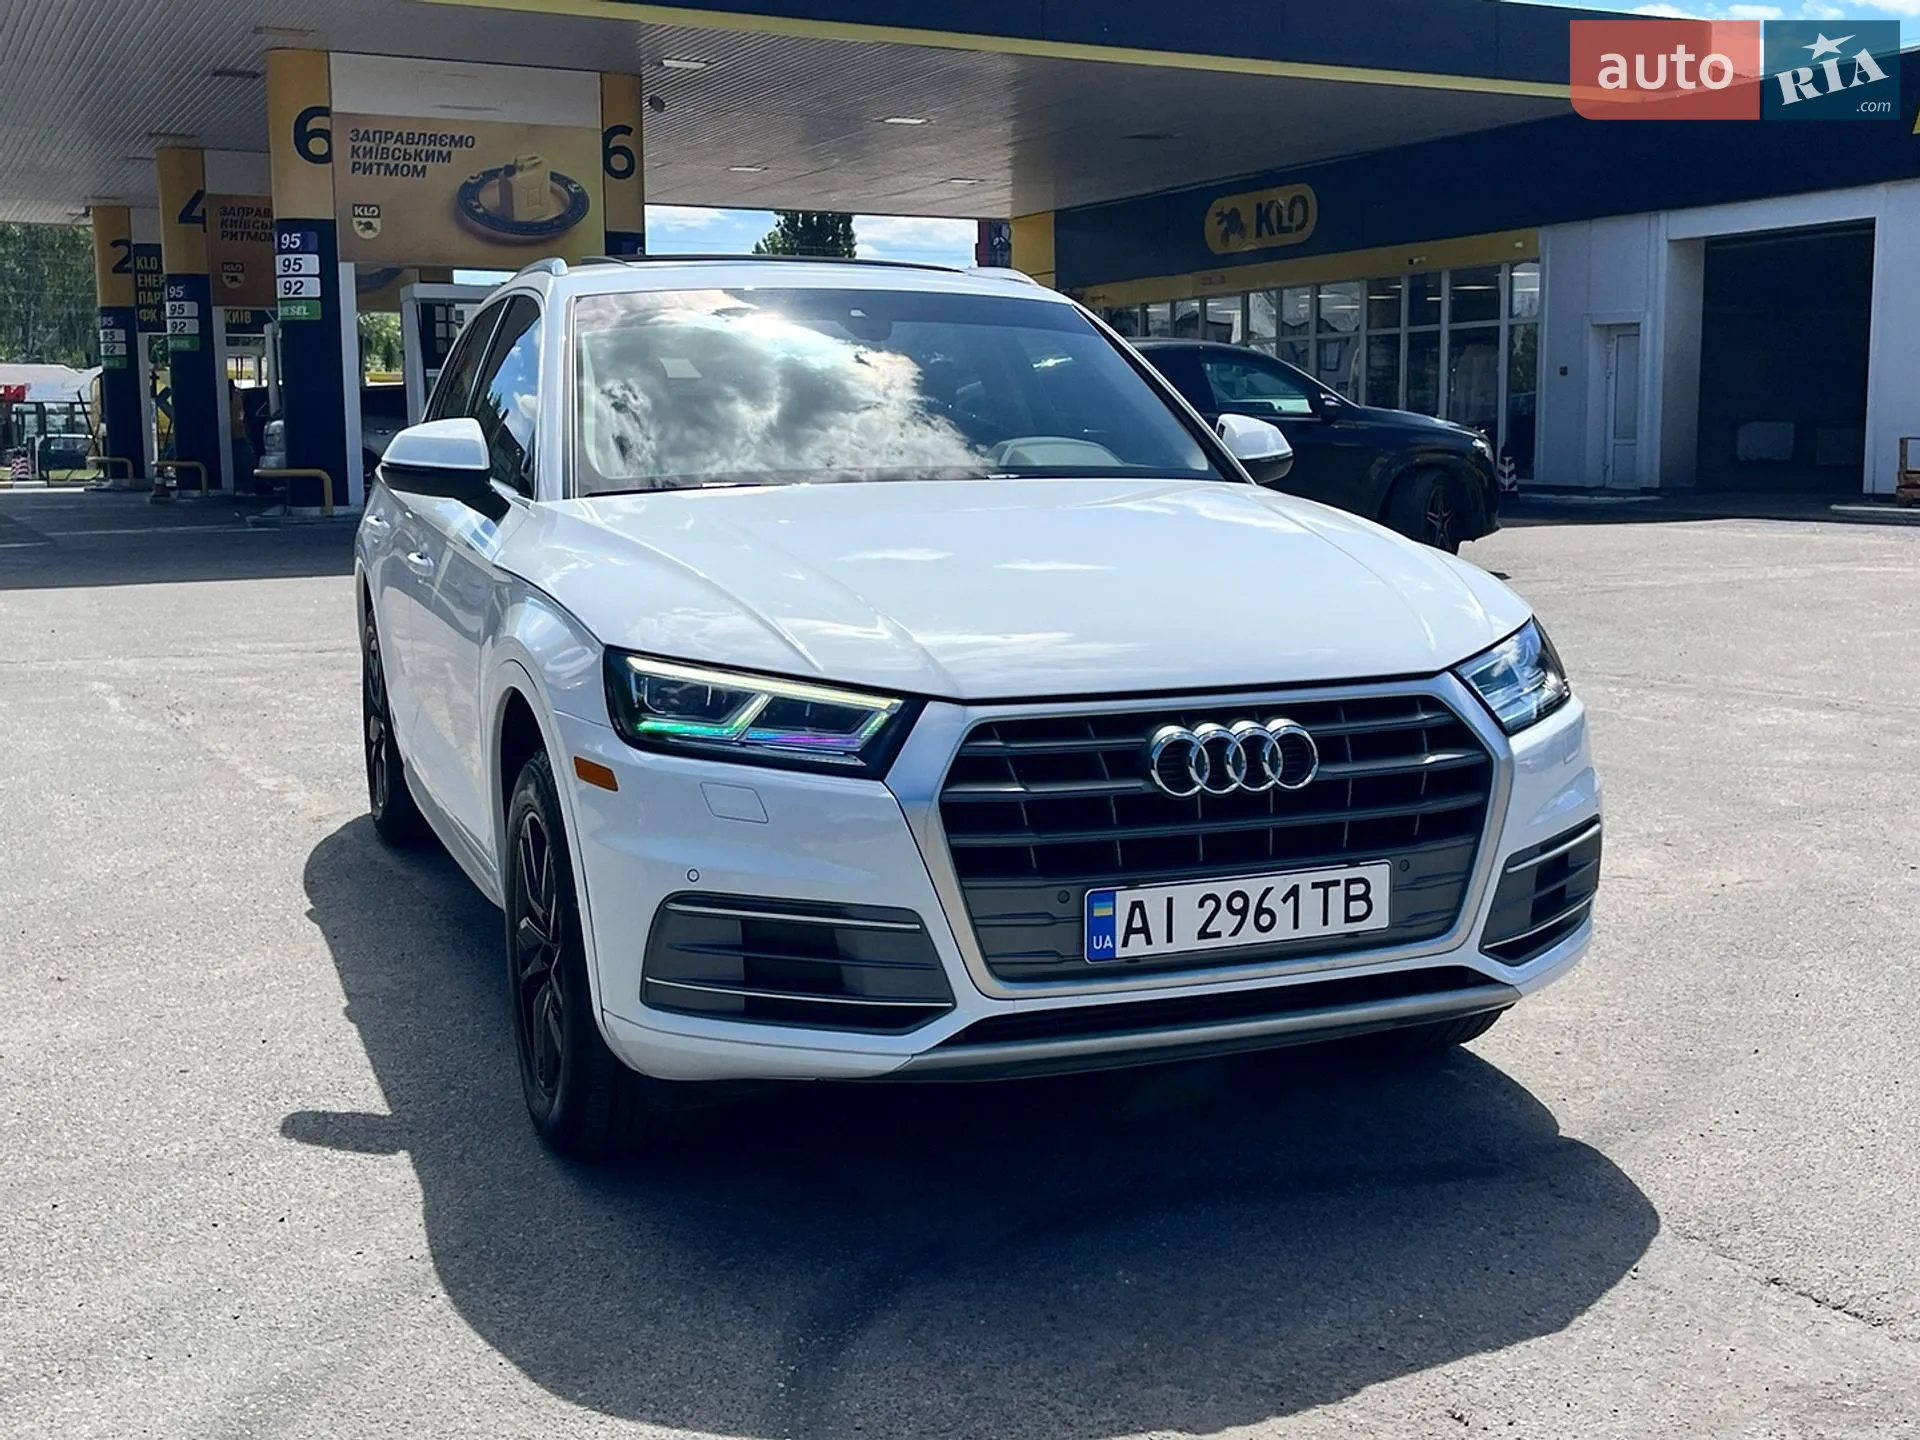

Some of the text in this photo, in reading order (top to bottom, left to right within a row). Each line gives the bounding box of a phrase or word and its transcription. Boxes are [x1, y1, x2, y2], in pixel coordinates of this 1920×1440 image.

[293, 106, 332, 164] 6
[350, 129, 475, 148] ЗАПРАВЛЯЄМО
[350, 144, 452, 163] КИЇВСЬКИМ
[602, 124, 636, 180] 6
[351, 161, 427, 178] РИТМОМ
[178, 189, 207, 233] 4
[219, 206, 273, 218] ЗАПРАВ
[353, 205, 379, 217] KLO
[1256, 194, 1309, 239] KLO
[281, 232, 301, 249] 95
[110, 238, 134, 274] 2
[282, 258, 303, 273] 95
[169, 284, 186, 298] 95
[283, 280, 304, 296] 92
[169, 303, 185, 315] 95
[170, 321, 187, 333] 92
[1093, 935, 1114, 950] UA
